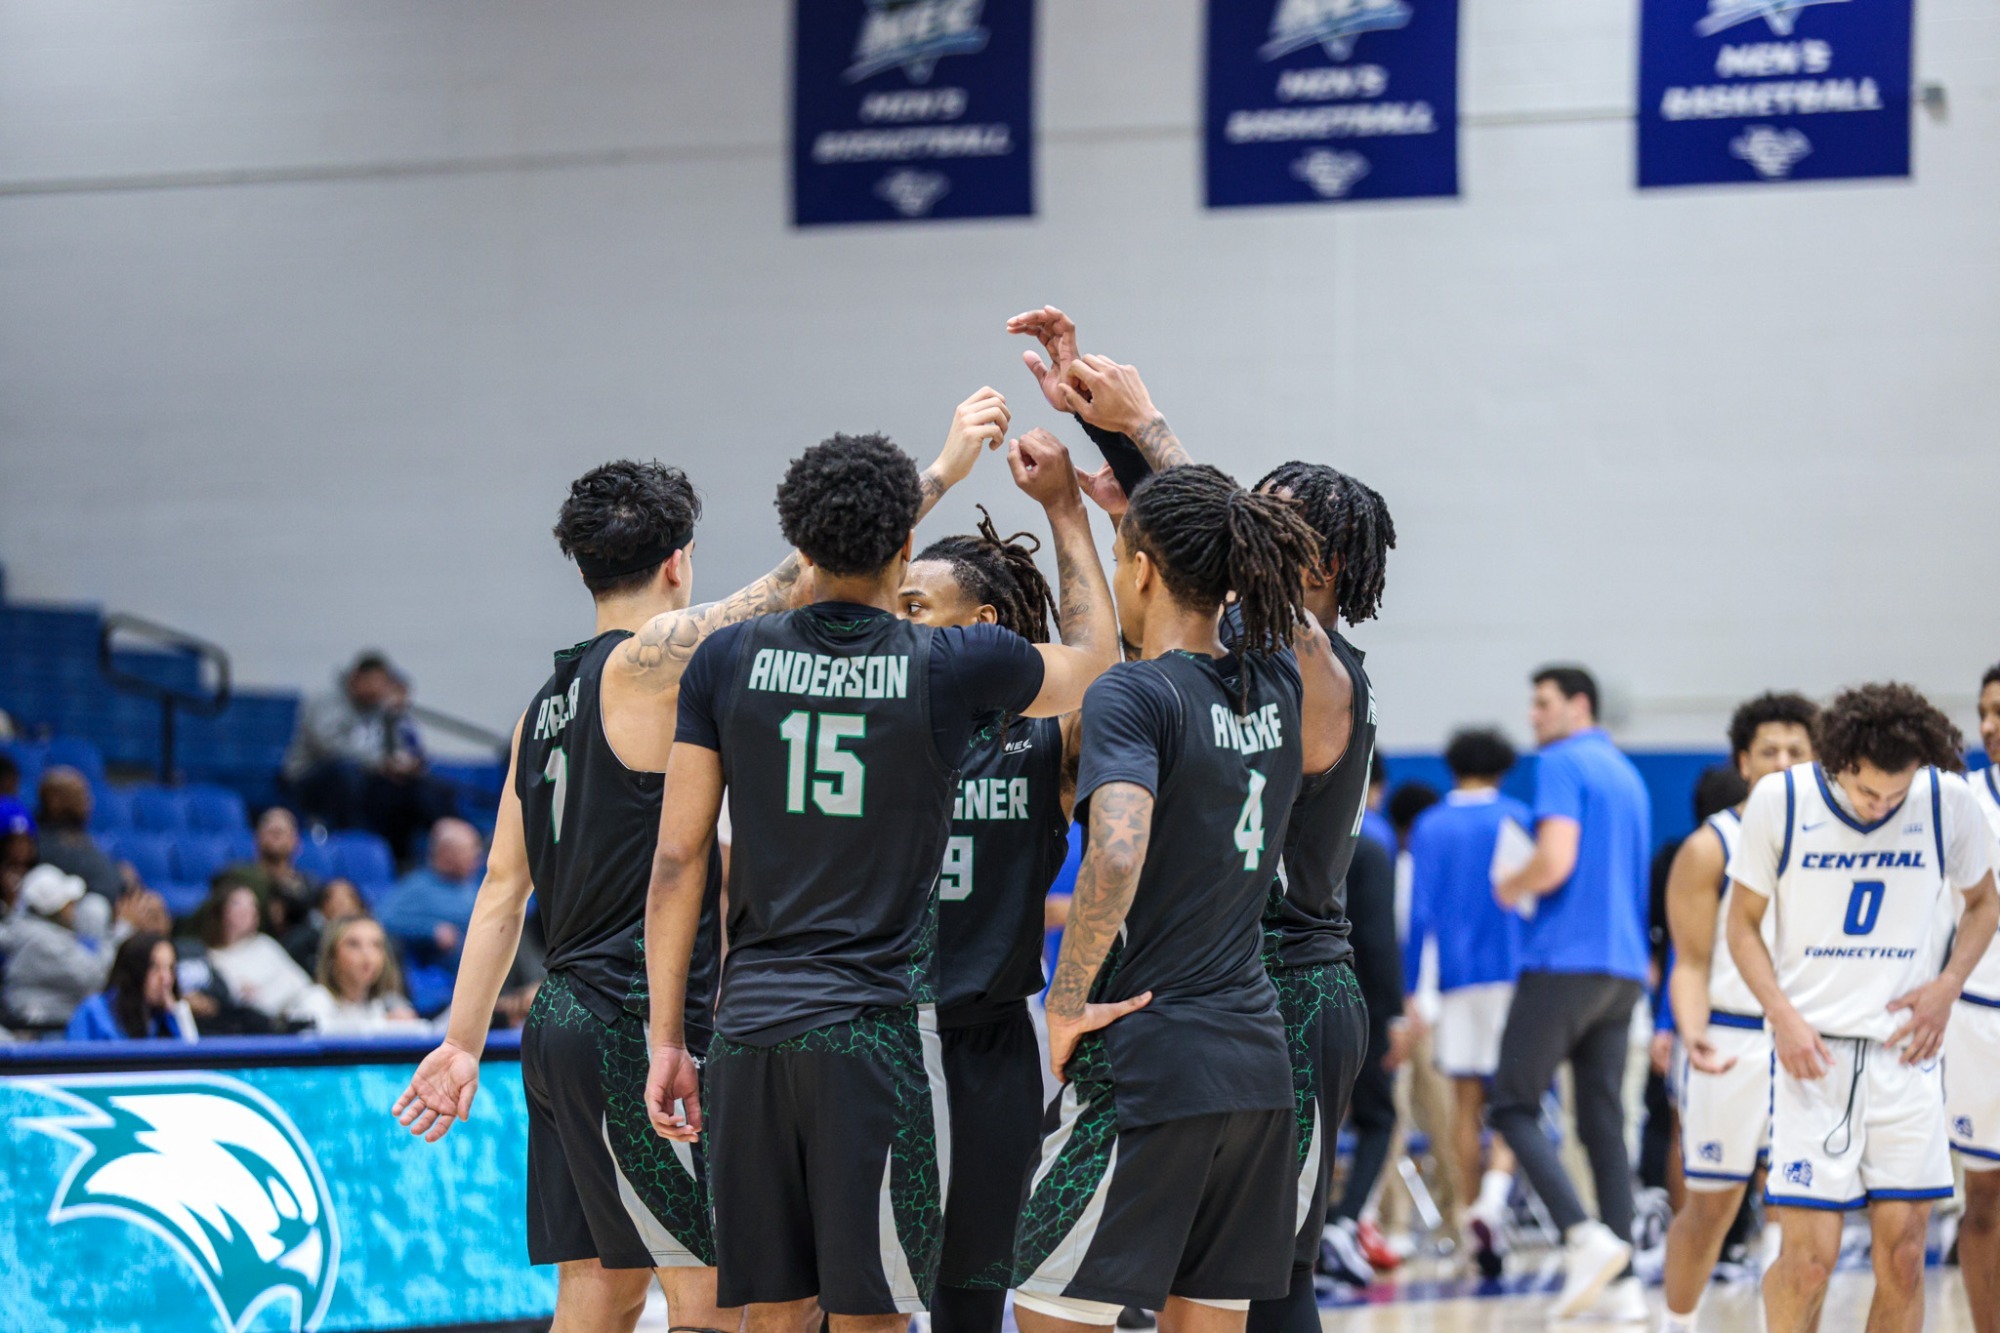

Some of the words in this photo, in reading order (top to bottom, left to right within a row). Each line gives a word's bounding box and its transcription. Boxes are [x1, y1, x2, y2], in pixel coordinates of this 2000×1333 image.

[1660, 76, 1883, 121] BASKETBALL
[748, 648, 909, 699] ANDERSON
[779, 709, 866, 818] 15
[1233, 768, 1268, 871] 4
[1801, 850, 1926, 869] CENTRAL
[1843, 880, 1886, 936] 0
[1804, 946, 1917, 960] CONNECTICUT
